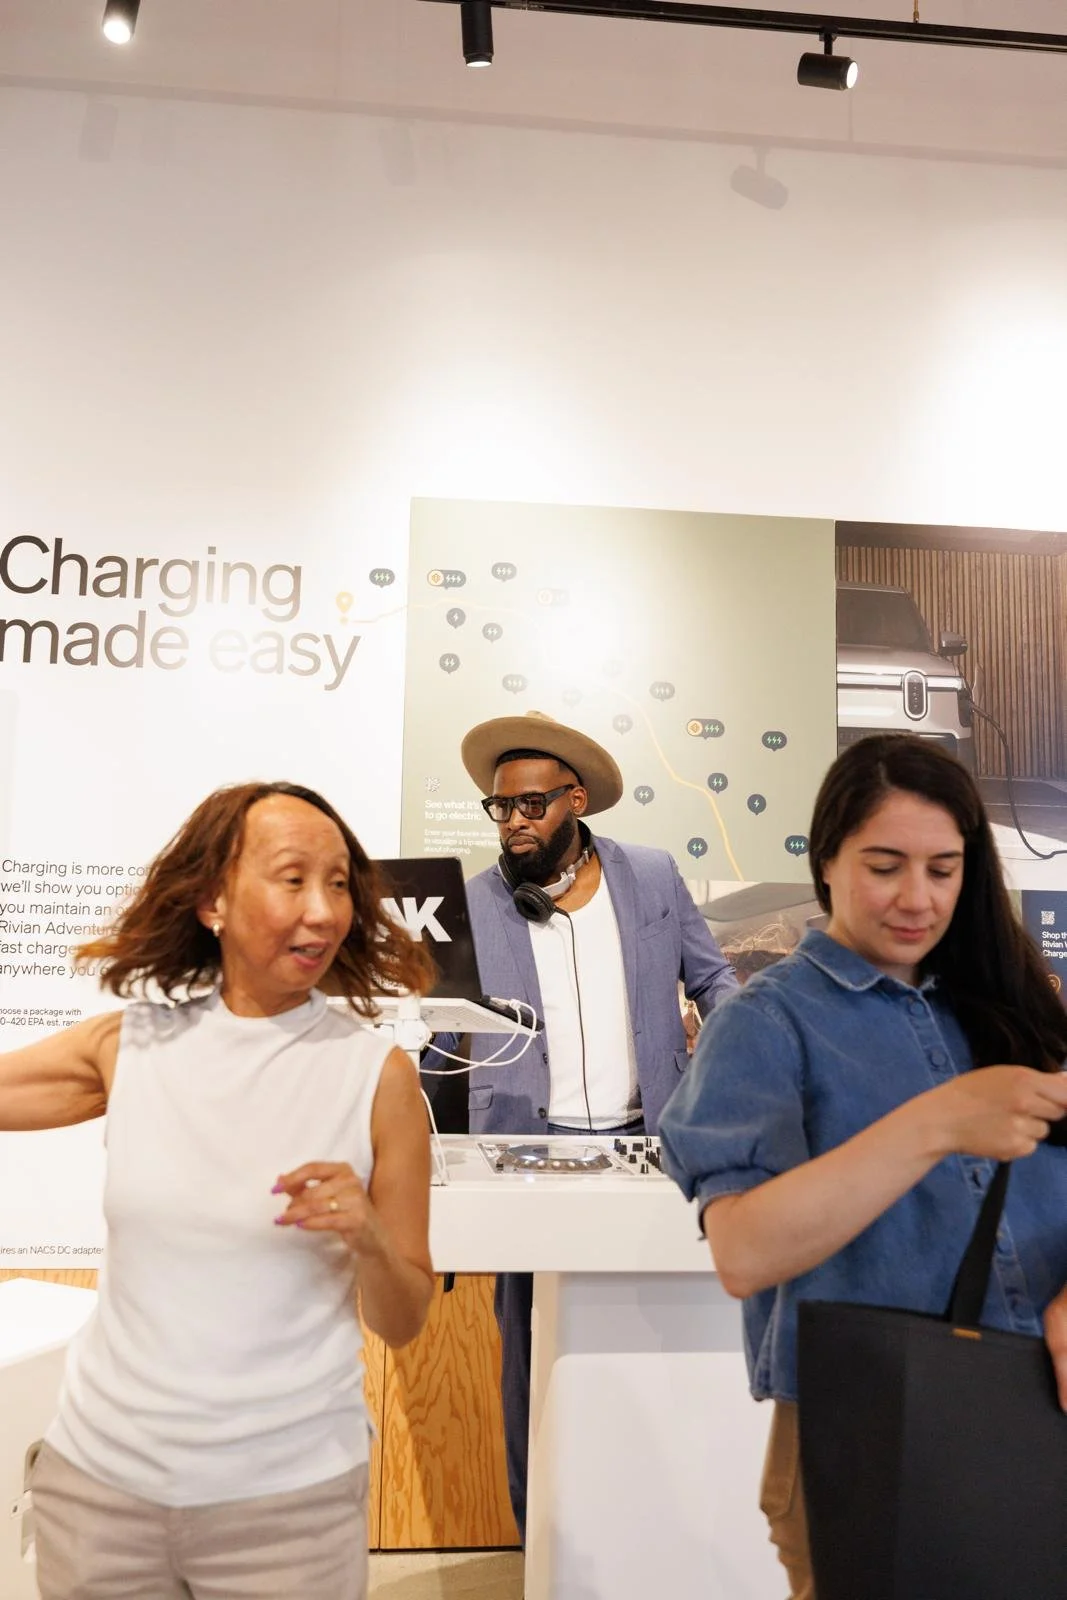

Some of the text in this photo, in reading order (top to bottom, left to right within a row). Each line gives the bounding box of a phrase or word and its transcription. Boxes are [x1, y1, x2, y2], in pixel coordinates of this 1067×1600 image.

[0, 535, 302, 622] Charging
[0, 610, 362, 691] made easy
[2, 860, 67, 877] Charging
[71, 861, 83, 875] is
[86, 865, 124, 876] more
[1, 880, 142, 898] we'll show you optio
[0, 903, 25, 916] you
[29, 902, 91, 916] maintain
[94, 905, 112, 916] an
[0, 920, 41, 934] Rivian
[1042, 932, 1060, 940] Shop
[27, 941, 80, 958] charge
[1043, 950, 1067, 958] Charge
[69, 966, 96, 979] you
[30, 1008, 63, 1017] package
[65, 1008, 82, 1016] with
[28, 1017, 44, 1026] EPA
[0, 1245, 16, 1255] ires
[17, 1246, 28, 1255] an
[30, 1245, 55, 1255] NACS
[57, 1245, 71, 1255] DC
